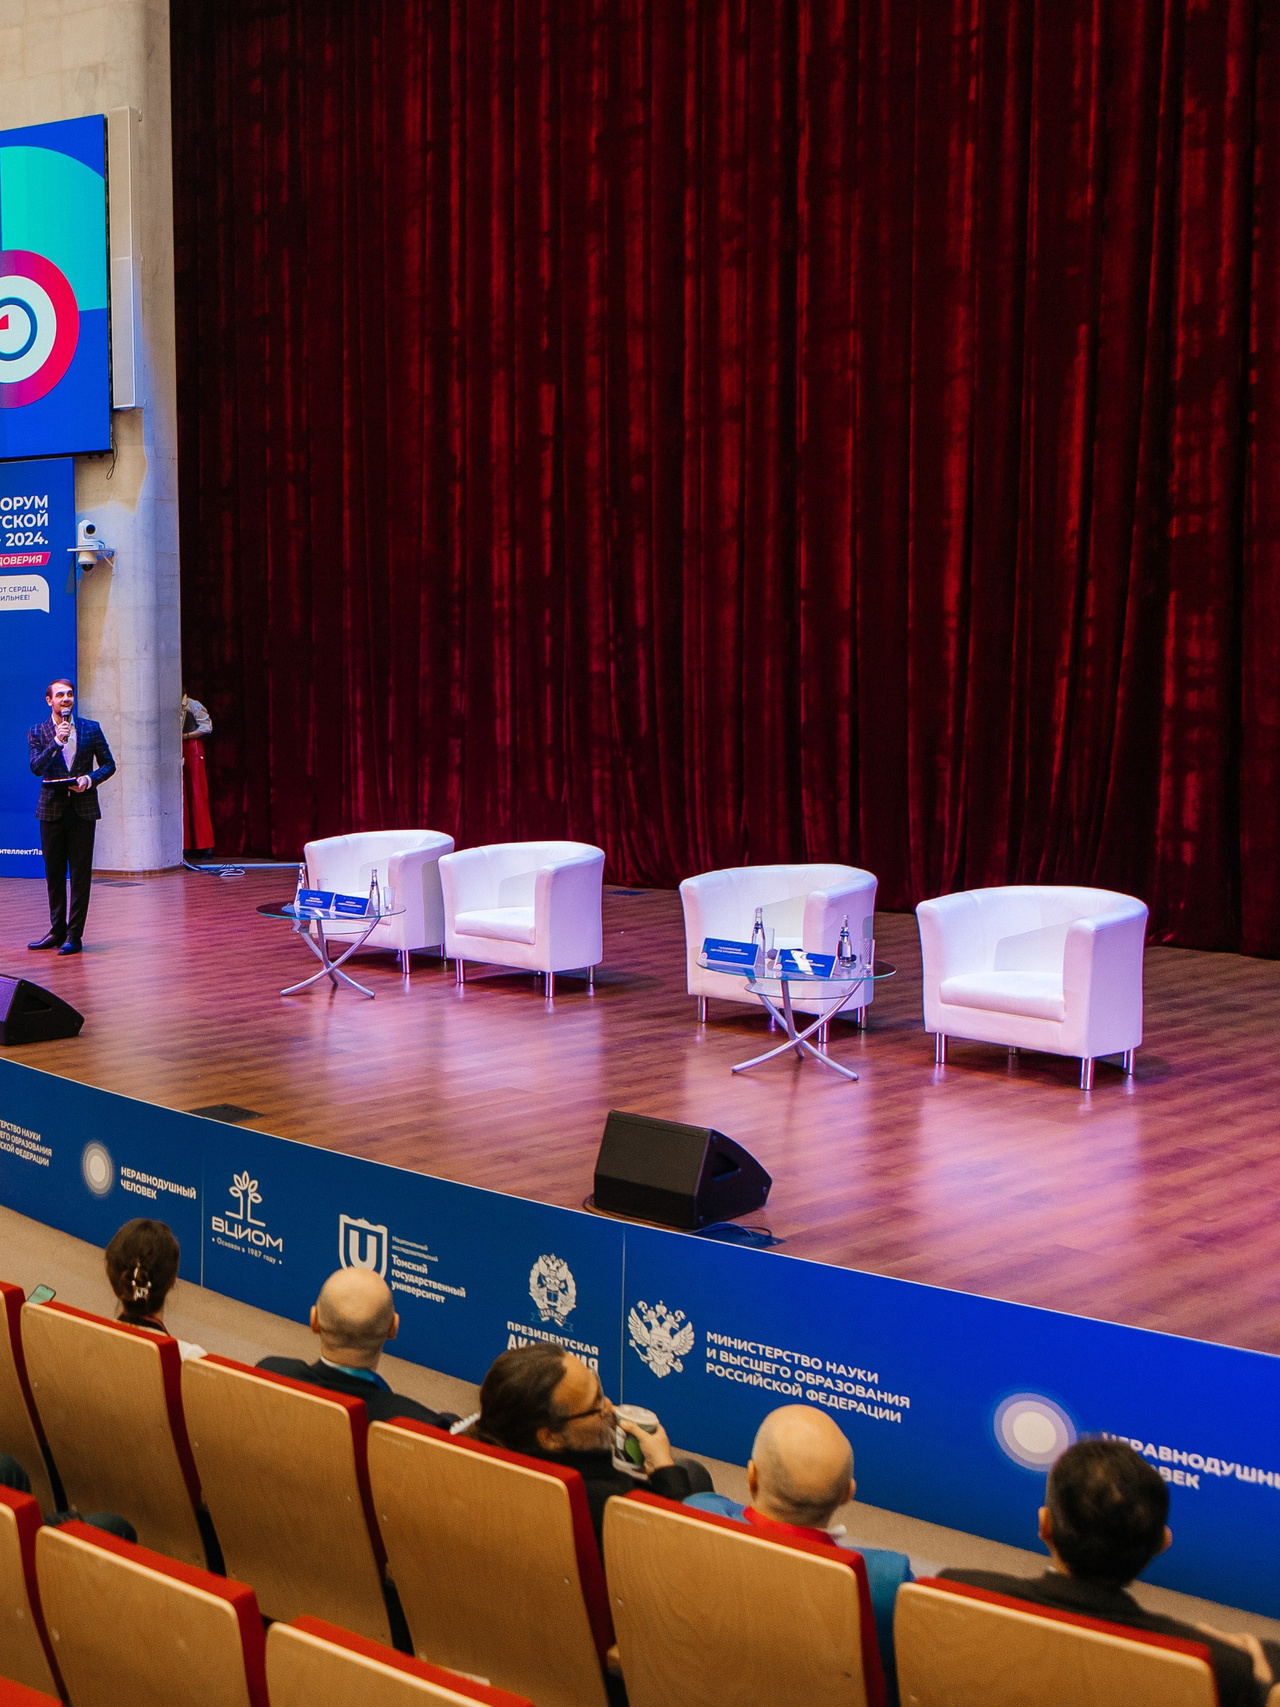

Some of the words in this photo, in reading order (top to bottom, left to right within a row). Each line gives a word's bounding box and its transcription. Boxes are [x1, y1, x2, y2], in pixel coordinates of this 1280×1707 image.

[6, 532, 48, 547] 2024.
[11, 1135, 52, 1157] ОБРАЗОВАНИЯ
[22, 1128, 41, 1142] НАУКИ
[15, 1148, 49, 1167] ФЕДЕРАЦИИ
[121, 1166, 197, 1200] НЕРАВНОДУШНЫЙ
[121, 1179, 157, 1200] ЧЕЛОВЕК
[212, 1216, 283, 1252] ВЦИОМ
[391, 1254, 428, 1274] Томский
[391, 1269, 466, 1298] государственный
[391, 1280, 445, 1303] университет
[507, 1320, 598, 1356] ПРЕЗИДЕНТСКАЯ
[706, 1331, 823, 1370] МИНИСТЕРСТВО
[826, 1360, 878, 1384] НАУКИ
[706, 1347, 717, 1359] И
[720, 1350, 791, 1378] ВЫСШЕГО
[794, 1370, 910, 1409] ОБРАЗОВАНИЯ
[706, 1362, 803, 1398] РОССИЙСКОЙ
[805, 1389, 901, 1424] ФЕДЕРАЦИИ
